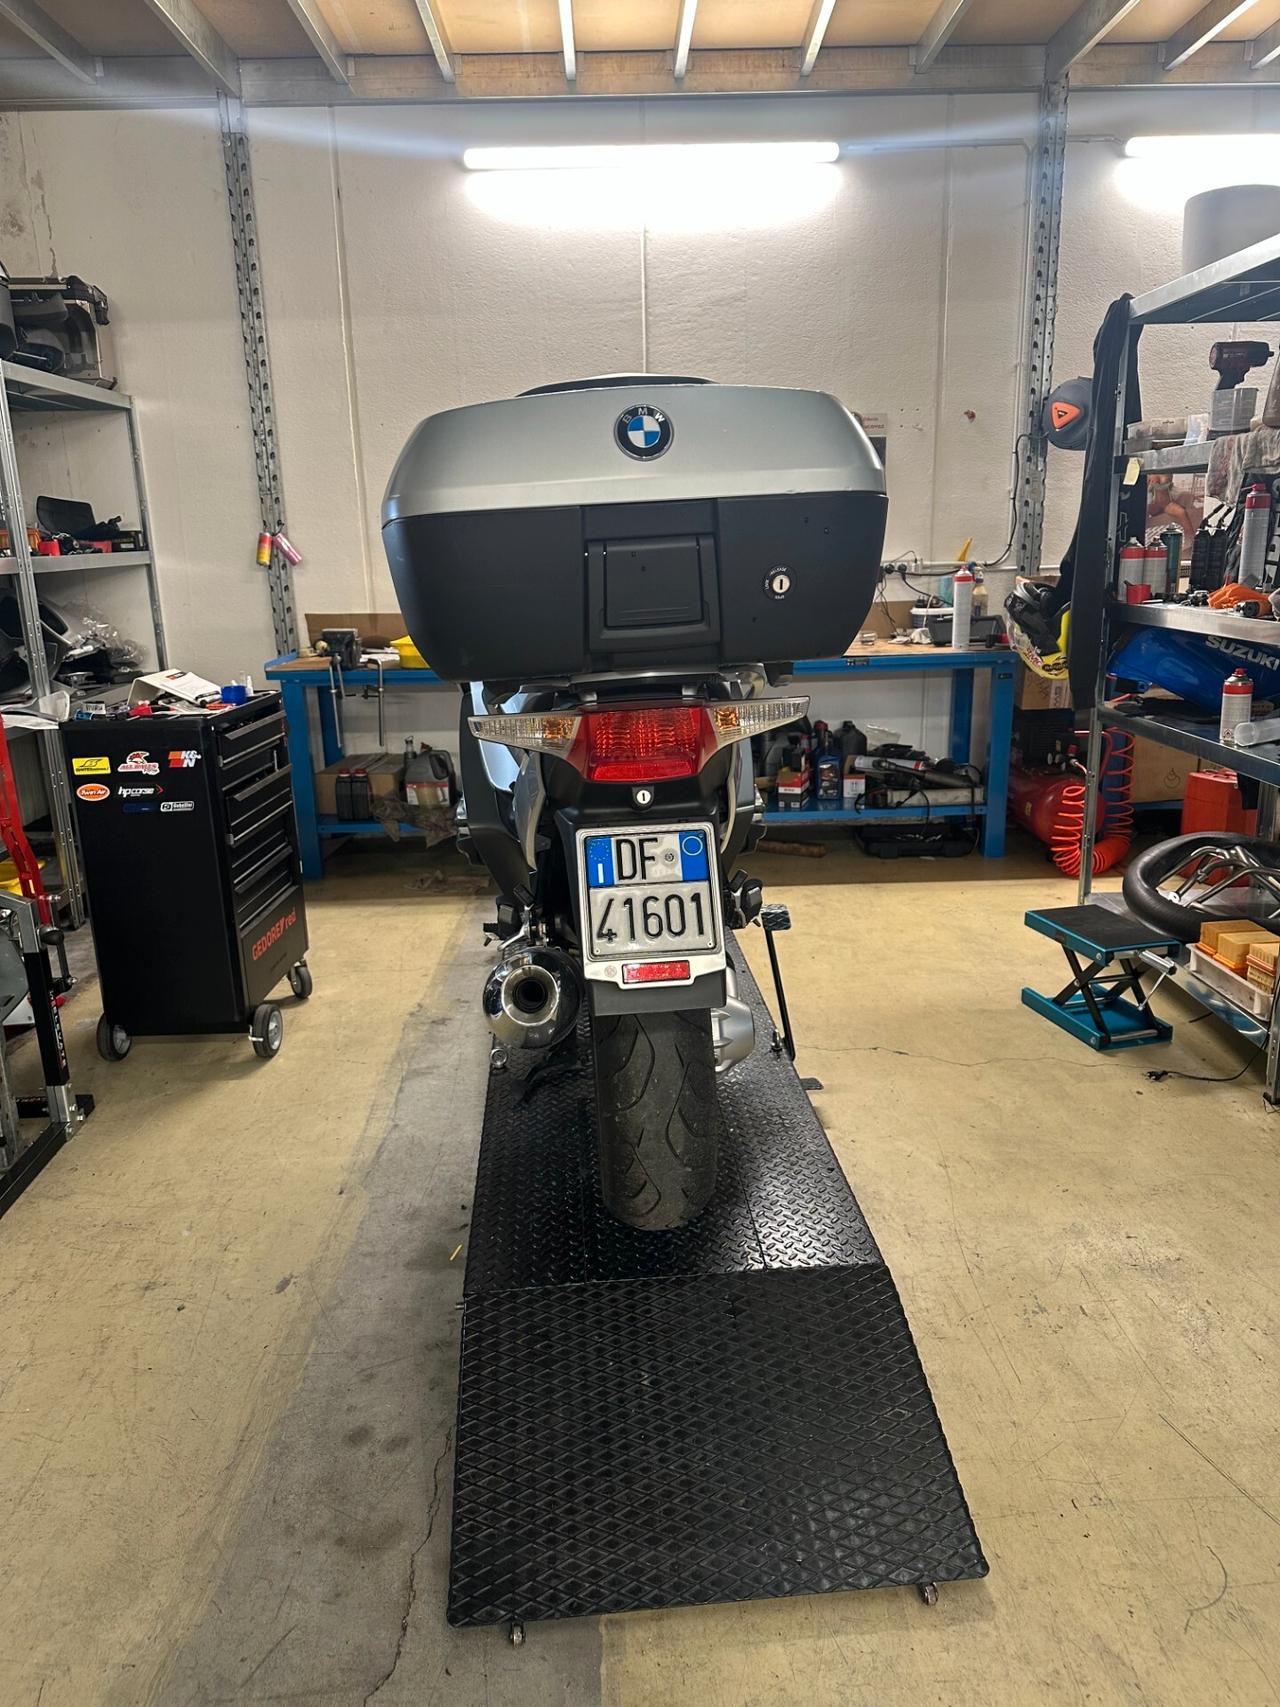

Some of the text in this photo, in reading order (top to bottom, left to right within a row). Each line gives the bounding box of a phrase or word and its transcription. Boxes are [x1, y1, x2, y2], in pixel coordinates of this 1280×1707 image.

[621, 407, 666, 424] BMW
[1205, 635, 1280, 671] SUZUKI
[616, 838, 658, 880] DF
[596, 892, 705, 943] 41601
